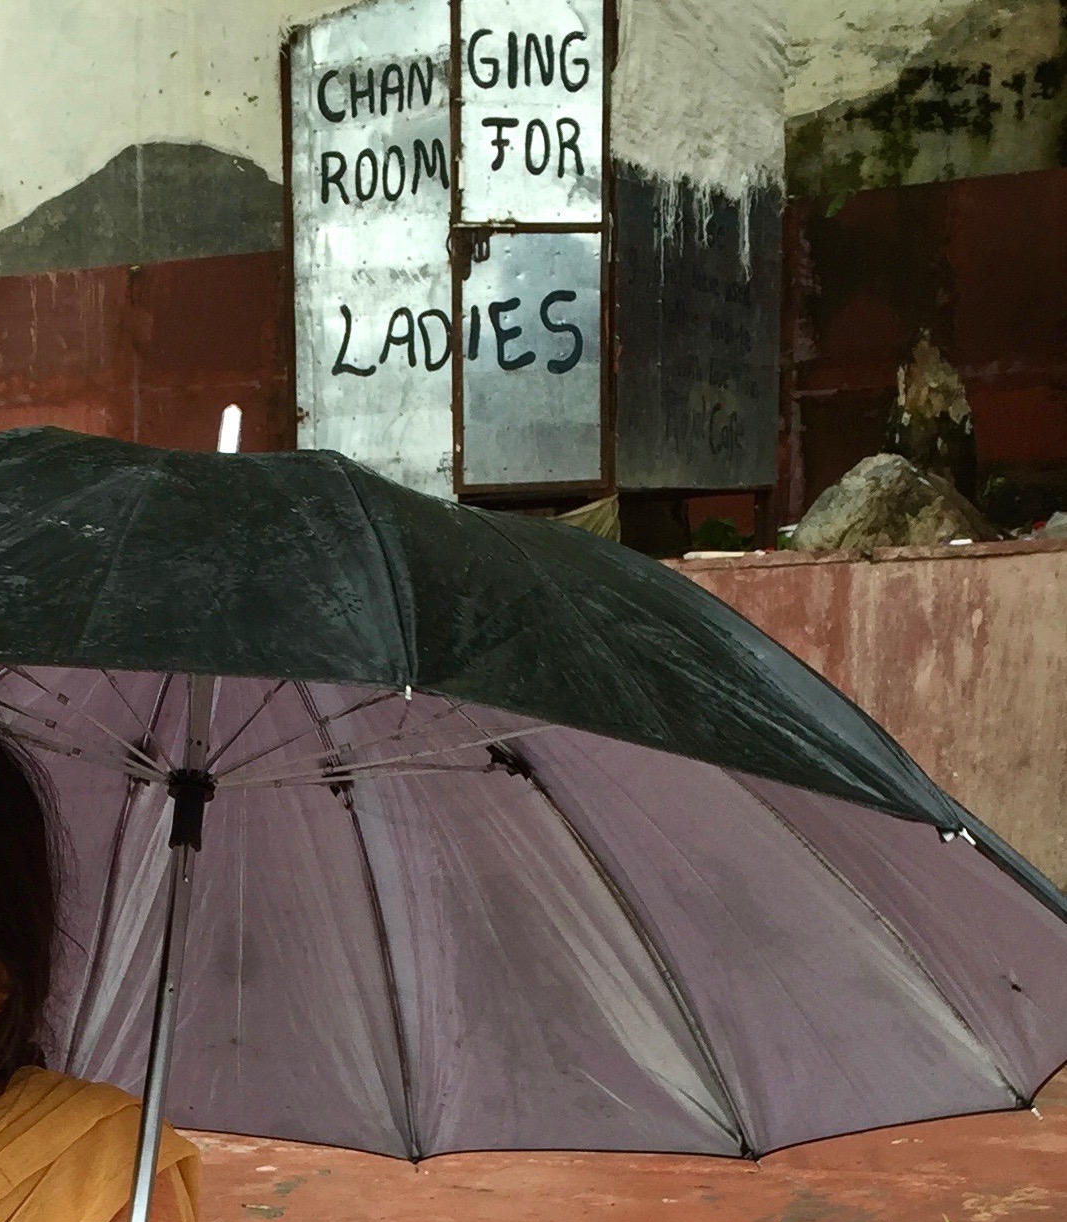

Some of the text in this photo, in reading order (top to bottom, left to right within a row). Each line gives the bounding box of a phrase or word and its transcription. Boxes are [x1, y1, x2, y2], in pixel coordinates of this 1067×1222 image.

[316, 28, 591, 123] CHAN GING
[320, 117, 585, 204] ROOM FOR
[331, 290, 584, 377] LADIES
